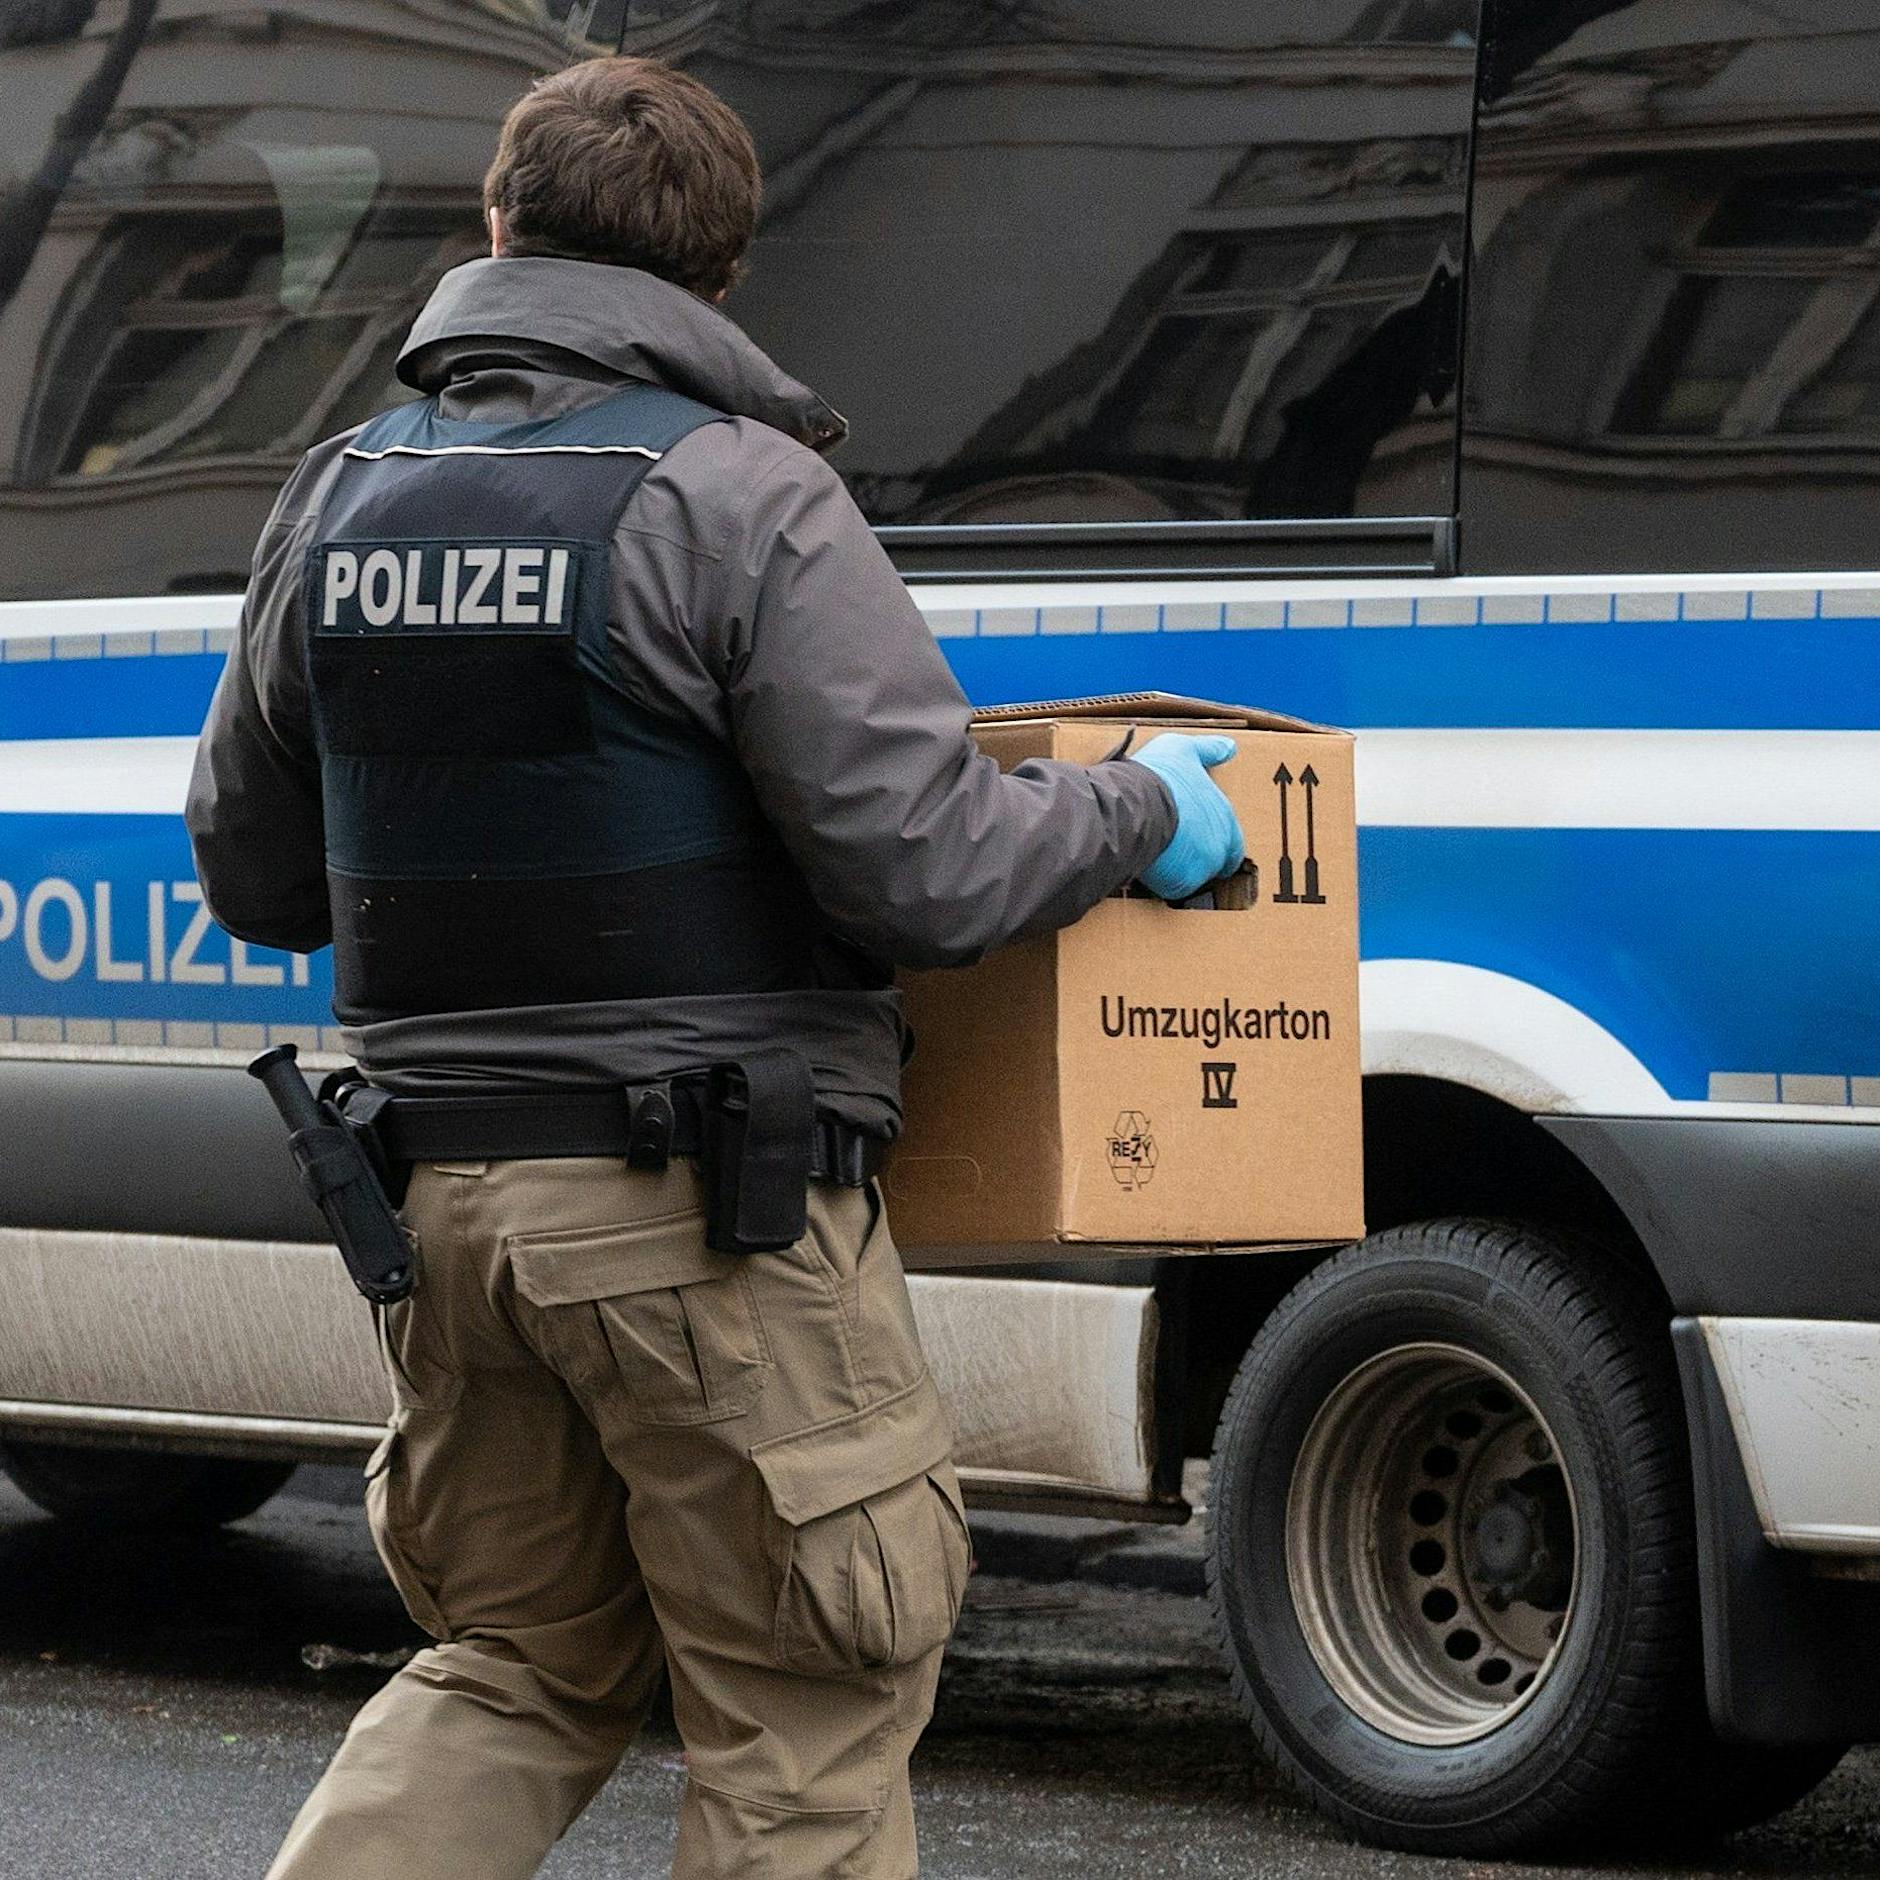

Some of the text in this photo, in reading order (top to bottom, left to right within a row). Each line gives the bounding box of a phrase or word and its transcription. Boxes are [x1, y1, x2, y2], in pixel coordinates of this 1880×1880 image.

[323, 548, 569, 627] POLIZEI
[1101, 995, 1330, 1049] Umzugkarton
[1201, 1062, 1238, 1108] IV
